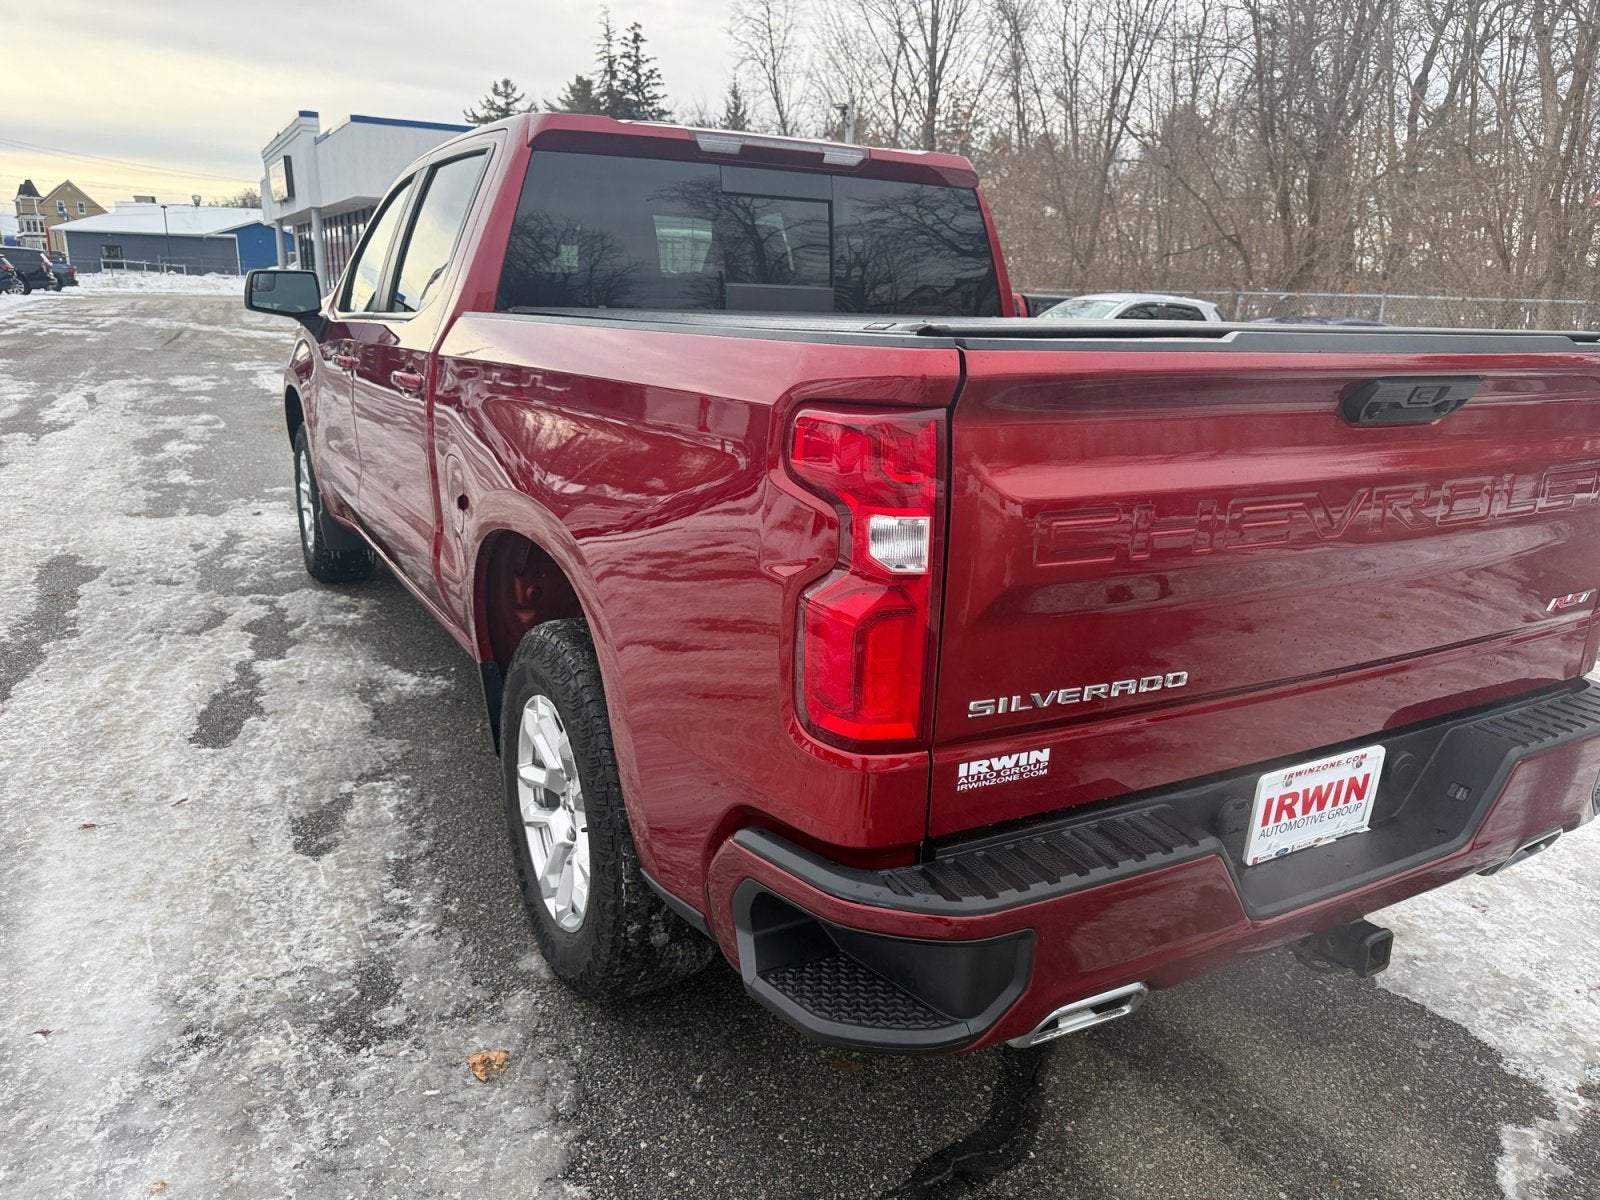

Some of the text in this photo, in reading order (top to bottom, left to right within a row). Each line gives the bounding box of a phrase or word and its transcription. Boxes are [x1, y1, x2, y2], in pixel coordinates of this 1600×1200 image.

[1546, 588, 1596, 612] RST
[967, 671, 1189, 718] SILVERADO
[957, 762, 1049, 785] AUTO GROUP
[958, 747, 1050, 777] IRWIN
[1283, 752, 1368, 781] IRWINZONE.COM
[956, 768, 1048, 792] IRWINZONE.COM
[1260, 773, 1371, 828] IRWIN
[1258, 811, 1326, 840] AUTOMOTIVE
[1327, 802, 1363, 820] GROUP
